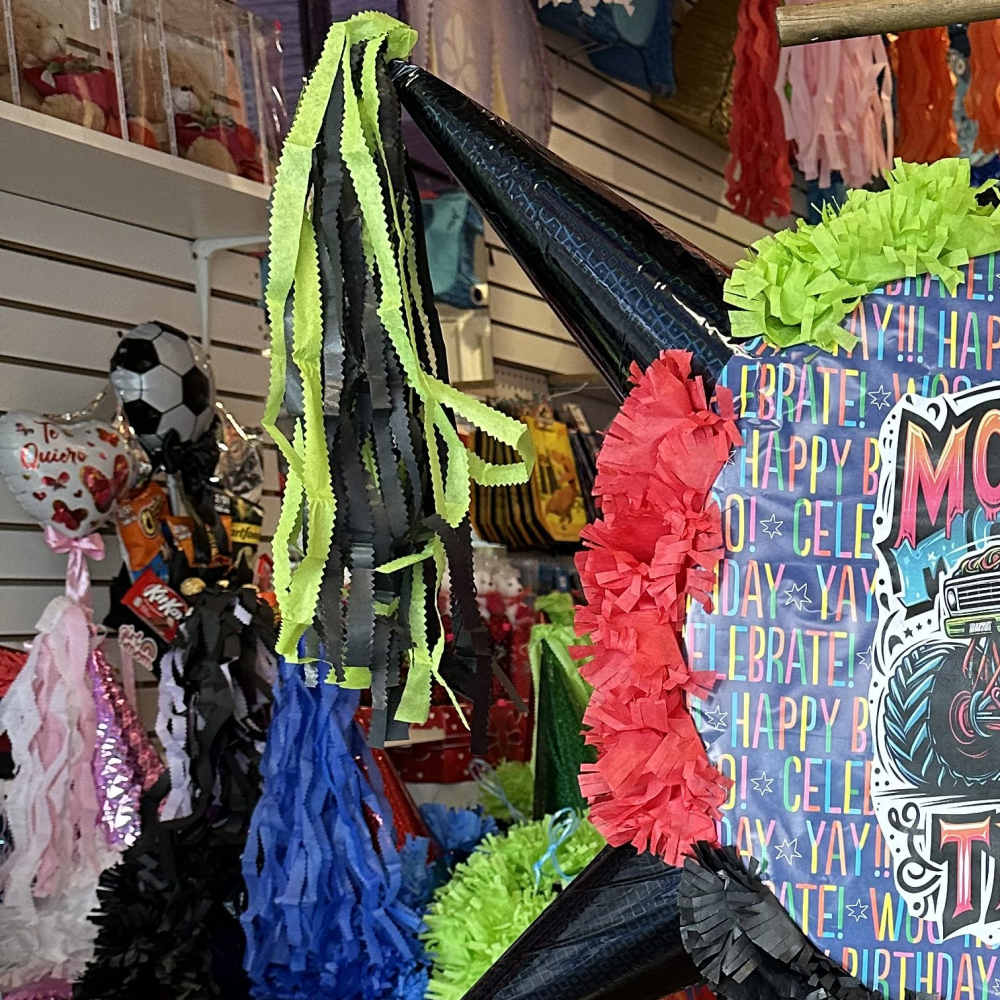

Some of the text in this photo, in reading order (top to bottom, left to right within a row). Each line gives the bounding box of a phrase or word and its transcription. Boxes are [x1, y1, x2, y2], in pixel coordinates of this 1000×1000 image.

[831, 301, 925, 363] AY!!!
[20, 442, 87, 469] Quiero
[33, 420, 59, 444] Te
[739, 428, 852, 496] HAPPY
[731, 691, 841, 753] HAPPY
